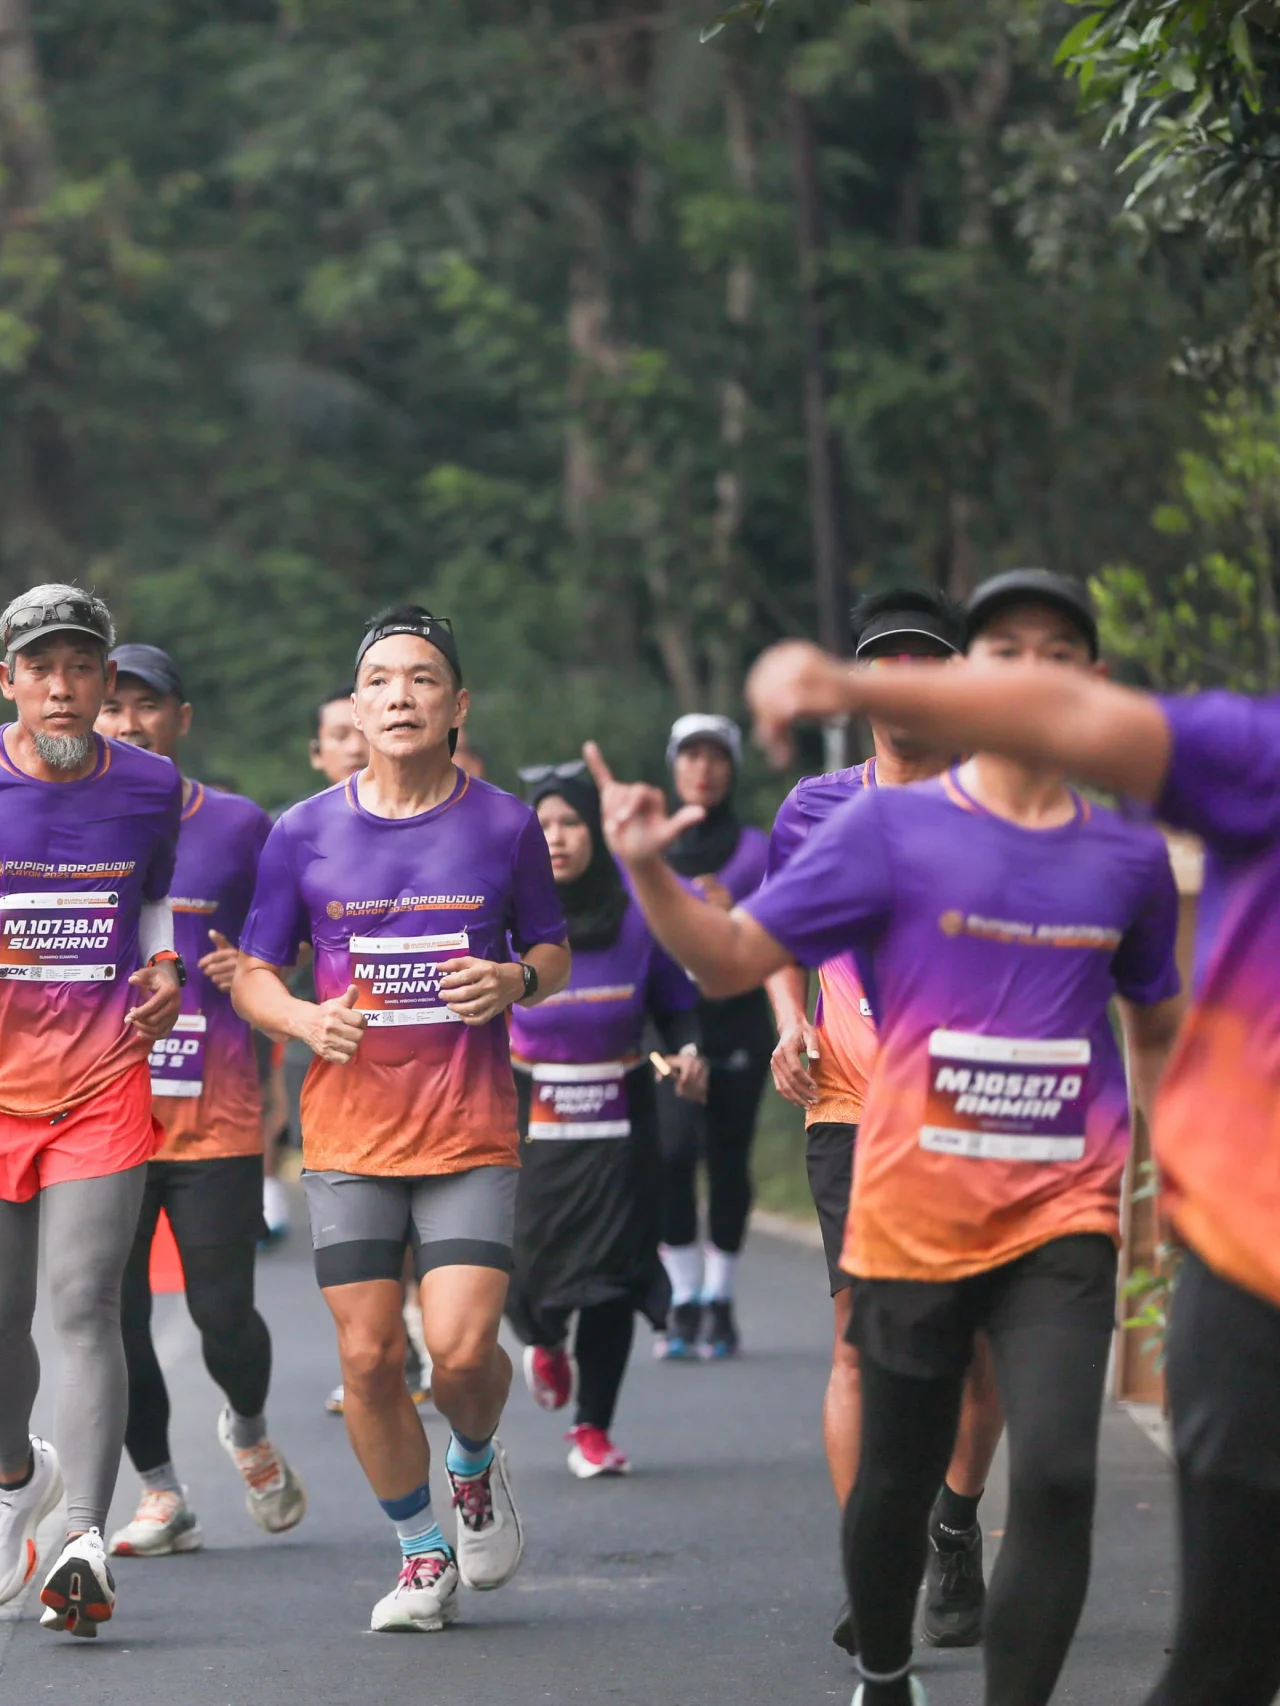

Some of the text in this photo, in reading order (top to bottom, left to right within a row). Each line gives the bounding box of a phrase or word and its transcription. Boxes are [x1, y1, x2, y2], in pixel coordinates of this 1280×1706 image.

[5, 861, 136, 872] RUPIAH BOROBUDUR
[346, 895, 485, 910] RUPIAH BOROBUDUR
[346, 908, 385, 916] PLAYON
[388, 905, 412, 913] 2025
[3, 918, 115, 935] M.10738.M
[7, 936, 109, 950] SUMARNO
[354, 962, 457, 980] M.10727.
[371, 979, 442, 994] DANNY
